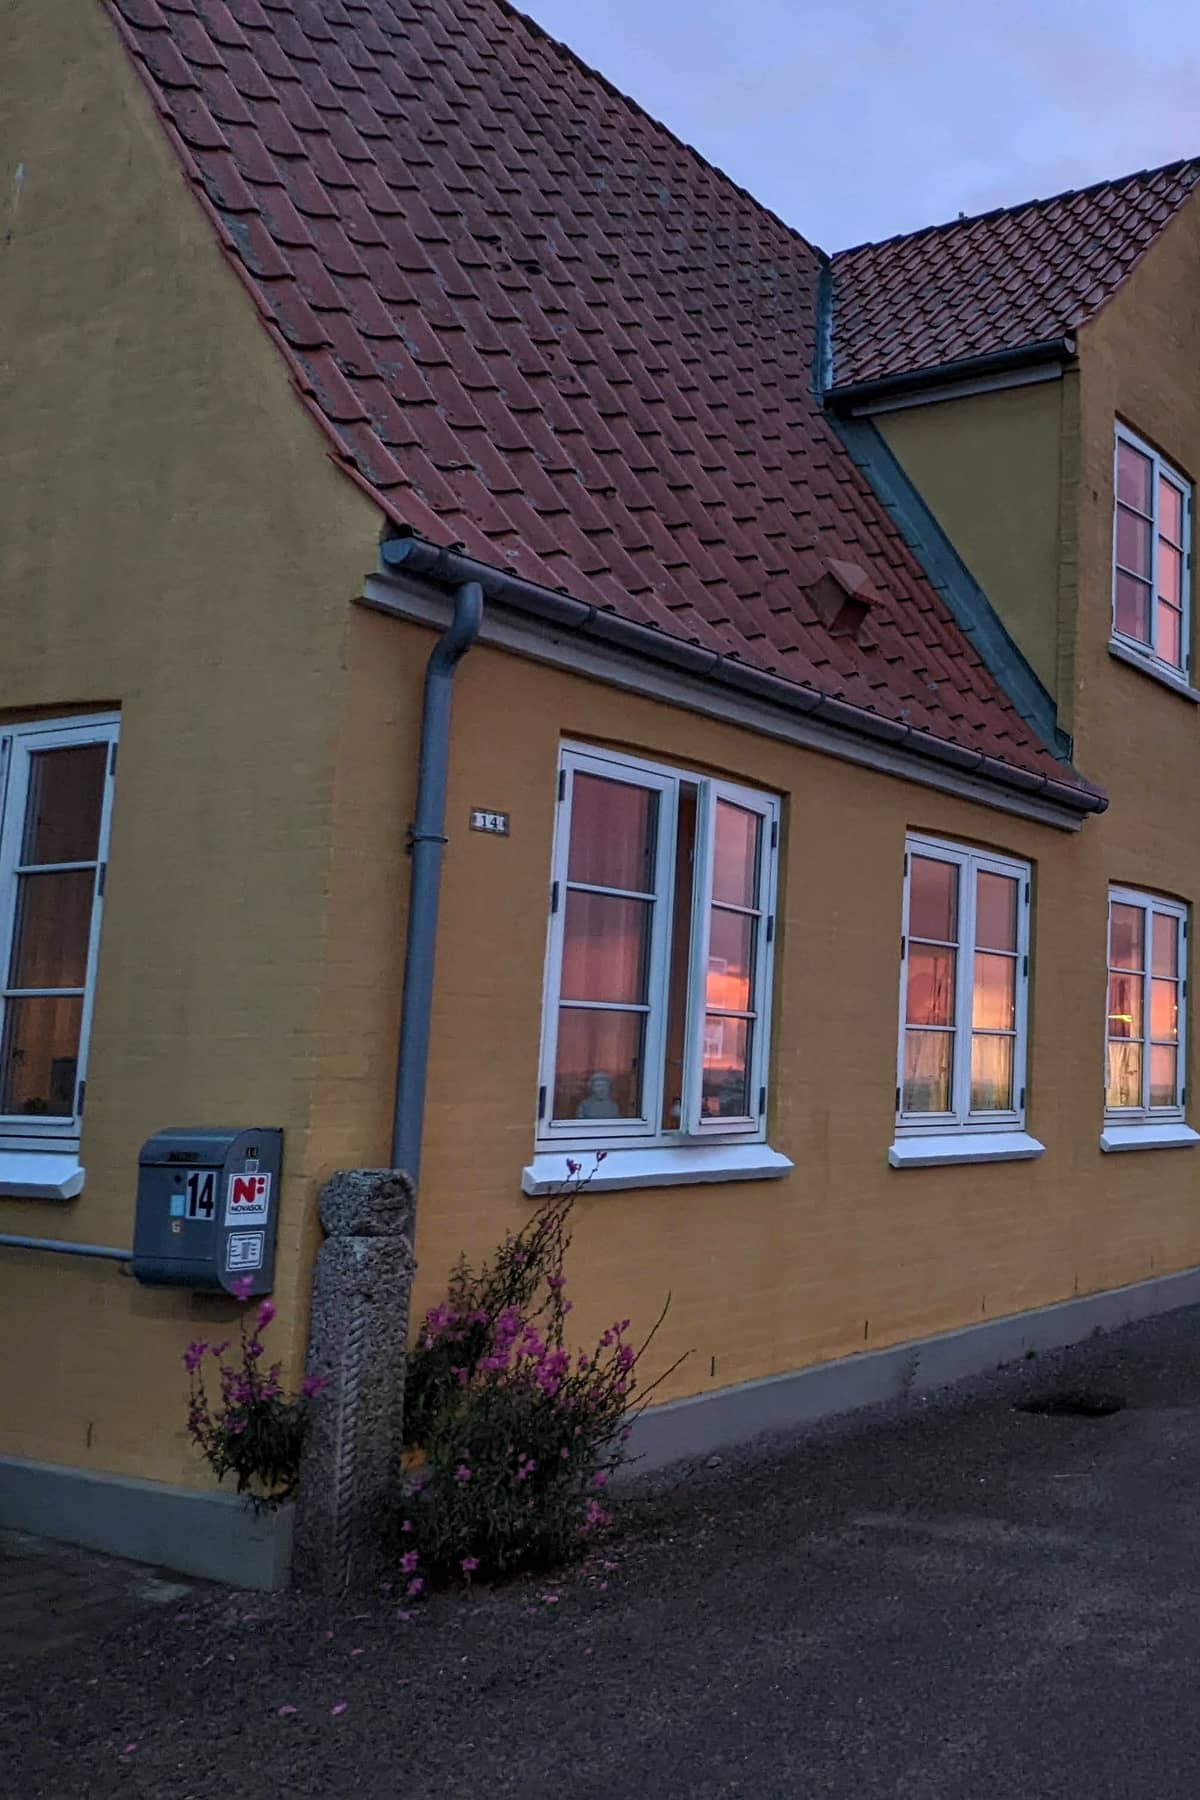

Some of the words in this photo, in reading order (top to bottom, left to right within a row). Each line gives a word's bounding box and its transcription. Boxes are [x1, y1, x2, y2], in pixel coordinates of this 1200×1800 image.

[481, 815, 498, 829] 14
[188, 1173, 214, 1218] 14
[231, 1204, 263, 1212] NOVASOL
